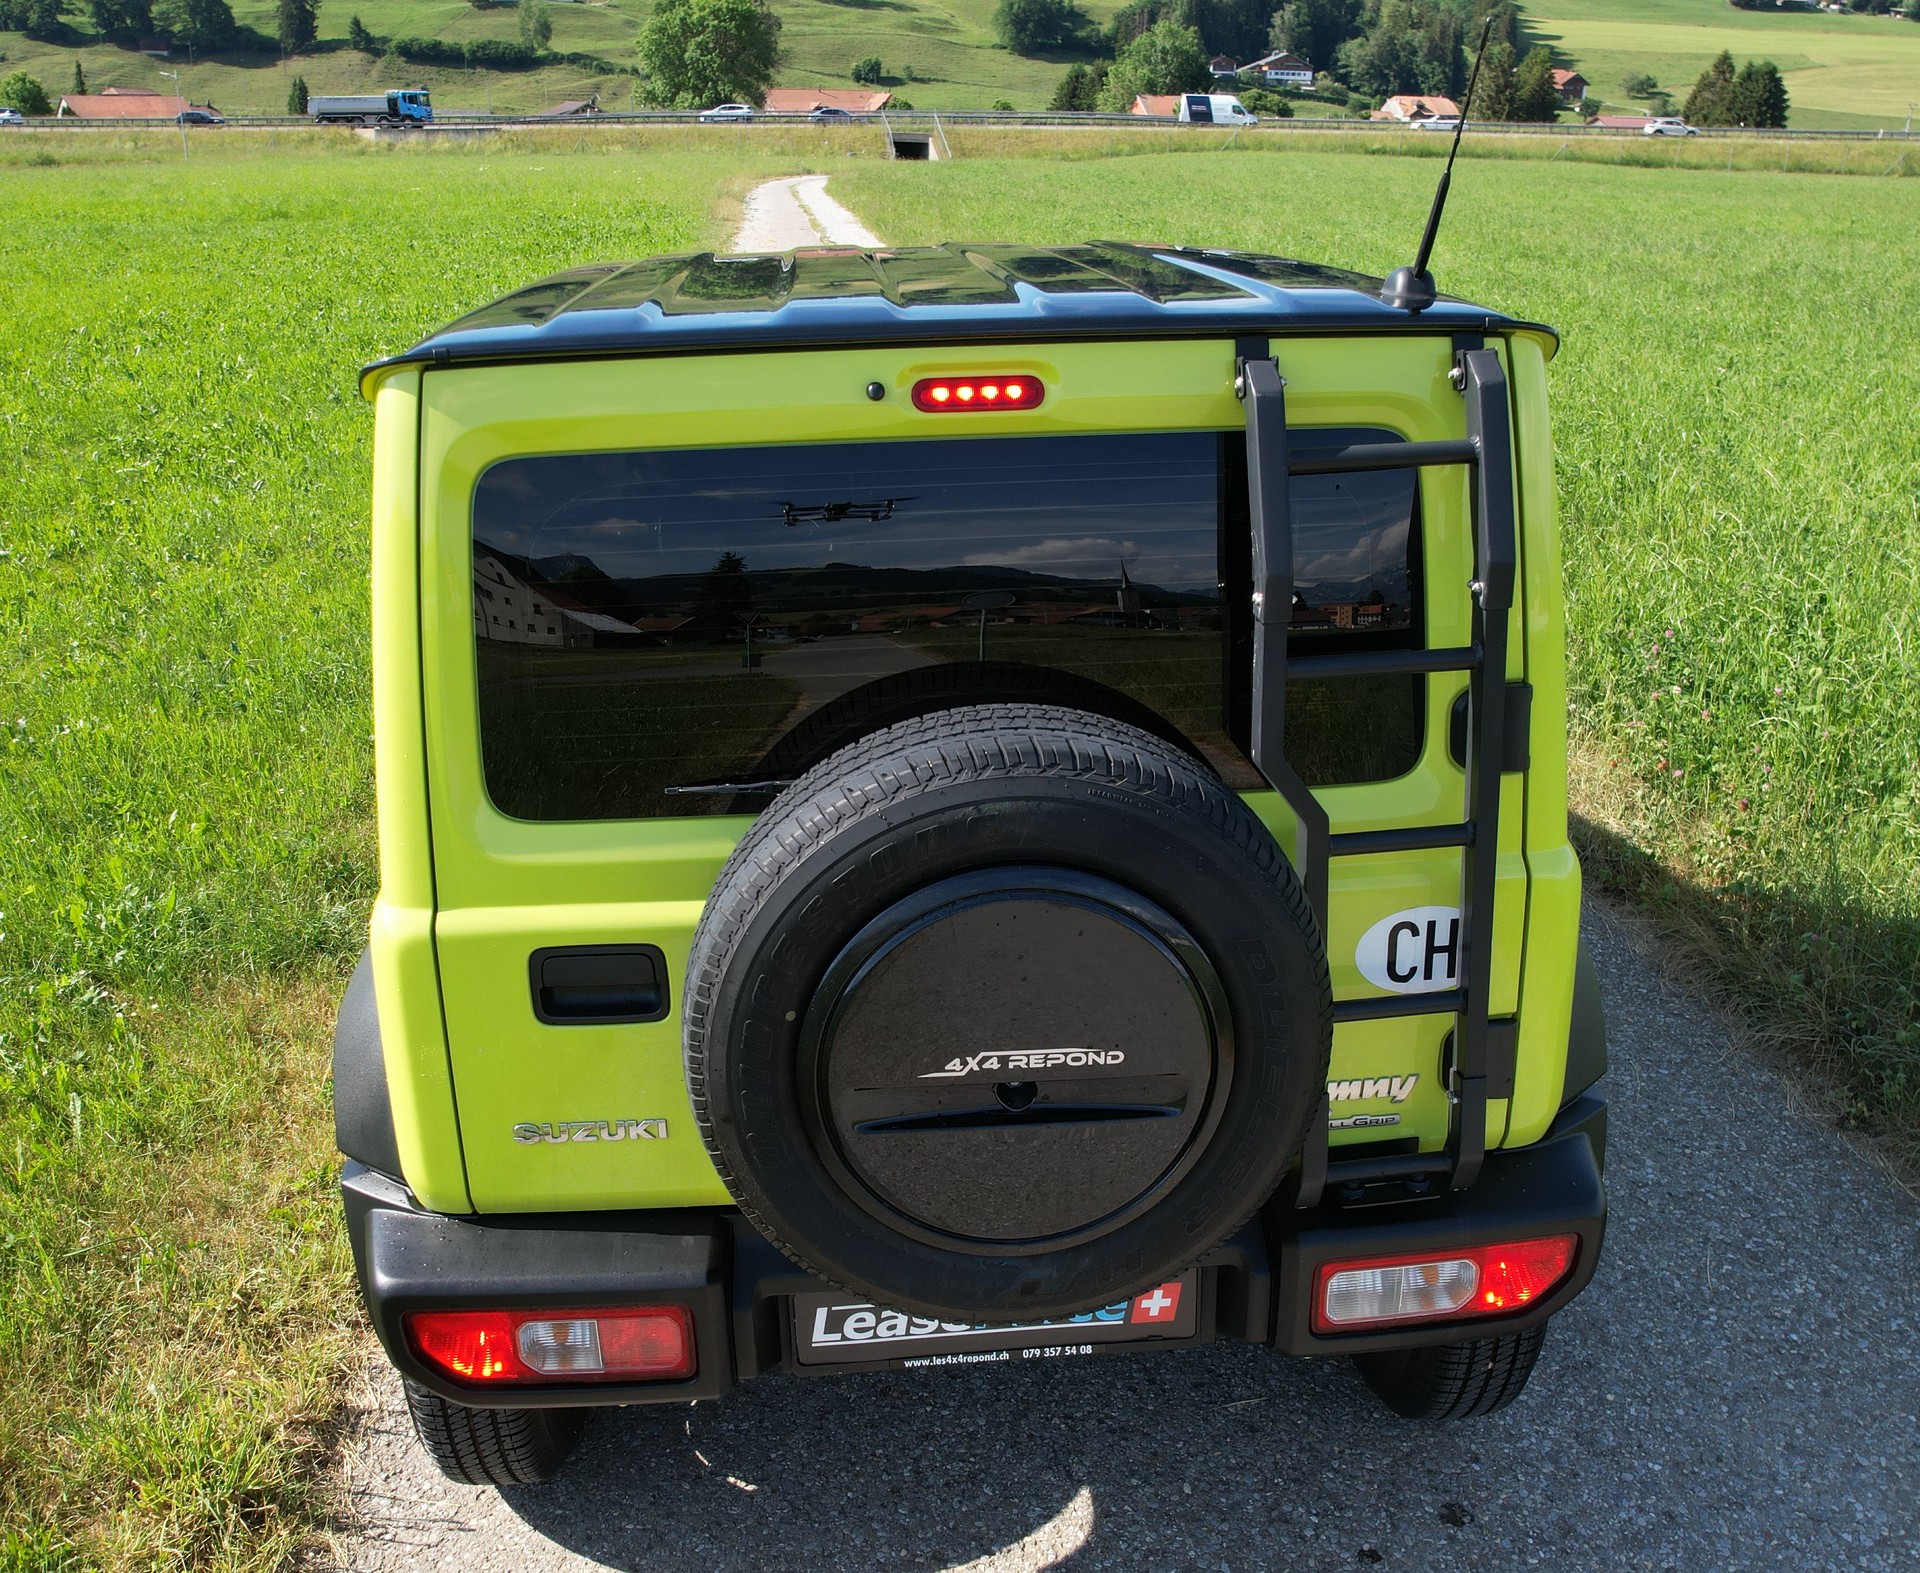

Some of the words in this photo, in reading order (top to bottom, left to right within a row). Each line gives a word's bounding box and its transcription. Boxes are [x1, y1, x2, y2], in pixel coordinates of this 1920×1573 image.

[1386, 918, 1460, 983] CH
[944, 1053, 1002, 1073] 4X4
[1008, 1050, 1125, 1069] REPOND
[1327, 1073, 1420, 1104] mny
[513, 1118, 669, 1145] SUZUKI
[1329, 1116, 1397, 1129] LLGRIP
[904, 1350, 1010, 1368] www.les4x4repond.ch
[1022, 1348, 1041, 1359] 079
[1043, 1347, 1061, 1358] 357
[1064, 1346, 1077, 1356] 54
[1080, 1345, 1093, 1355] 08
